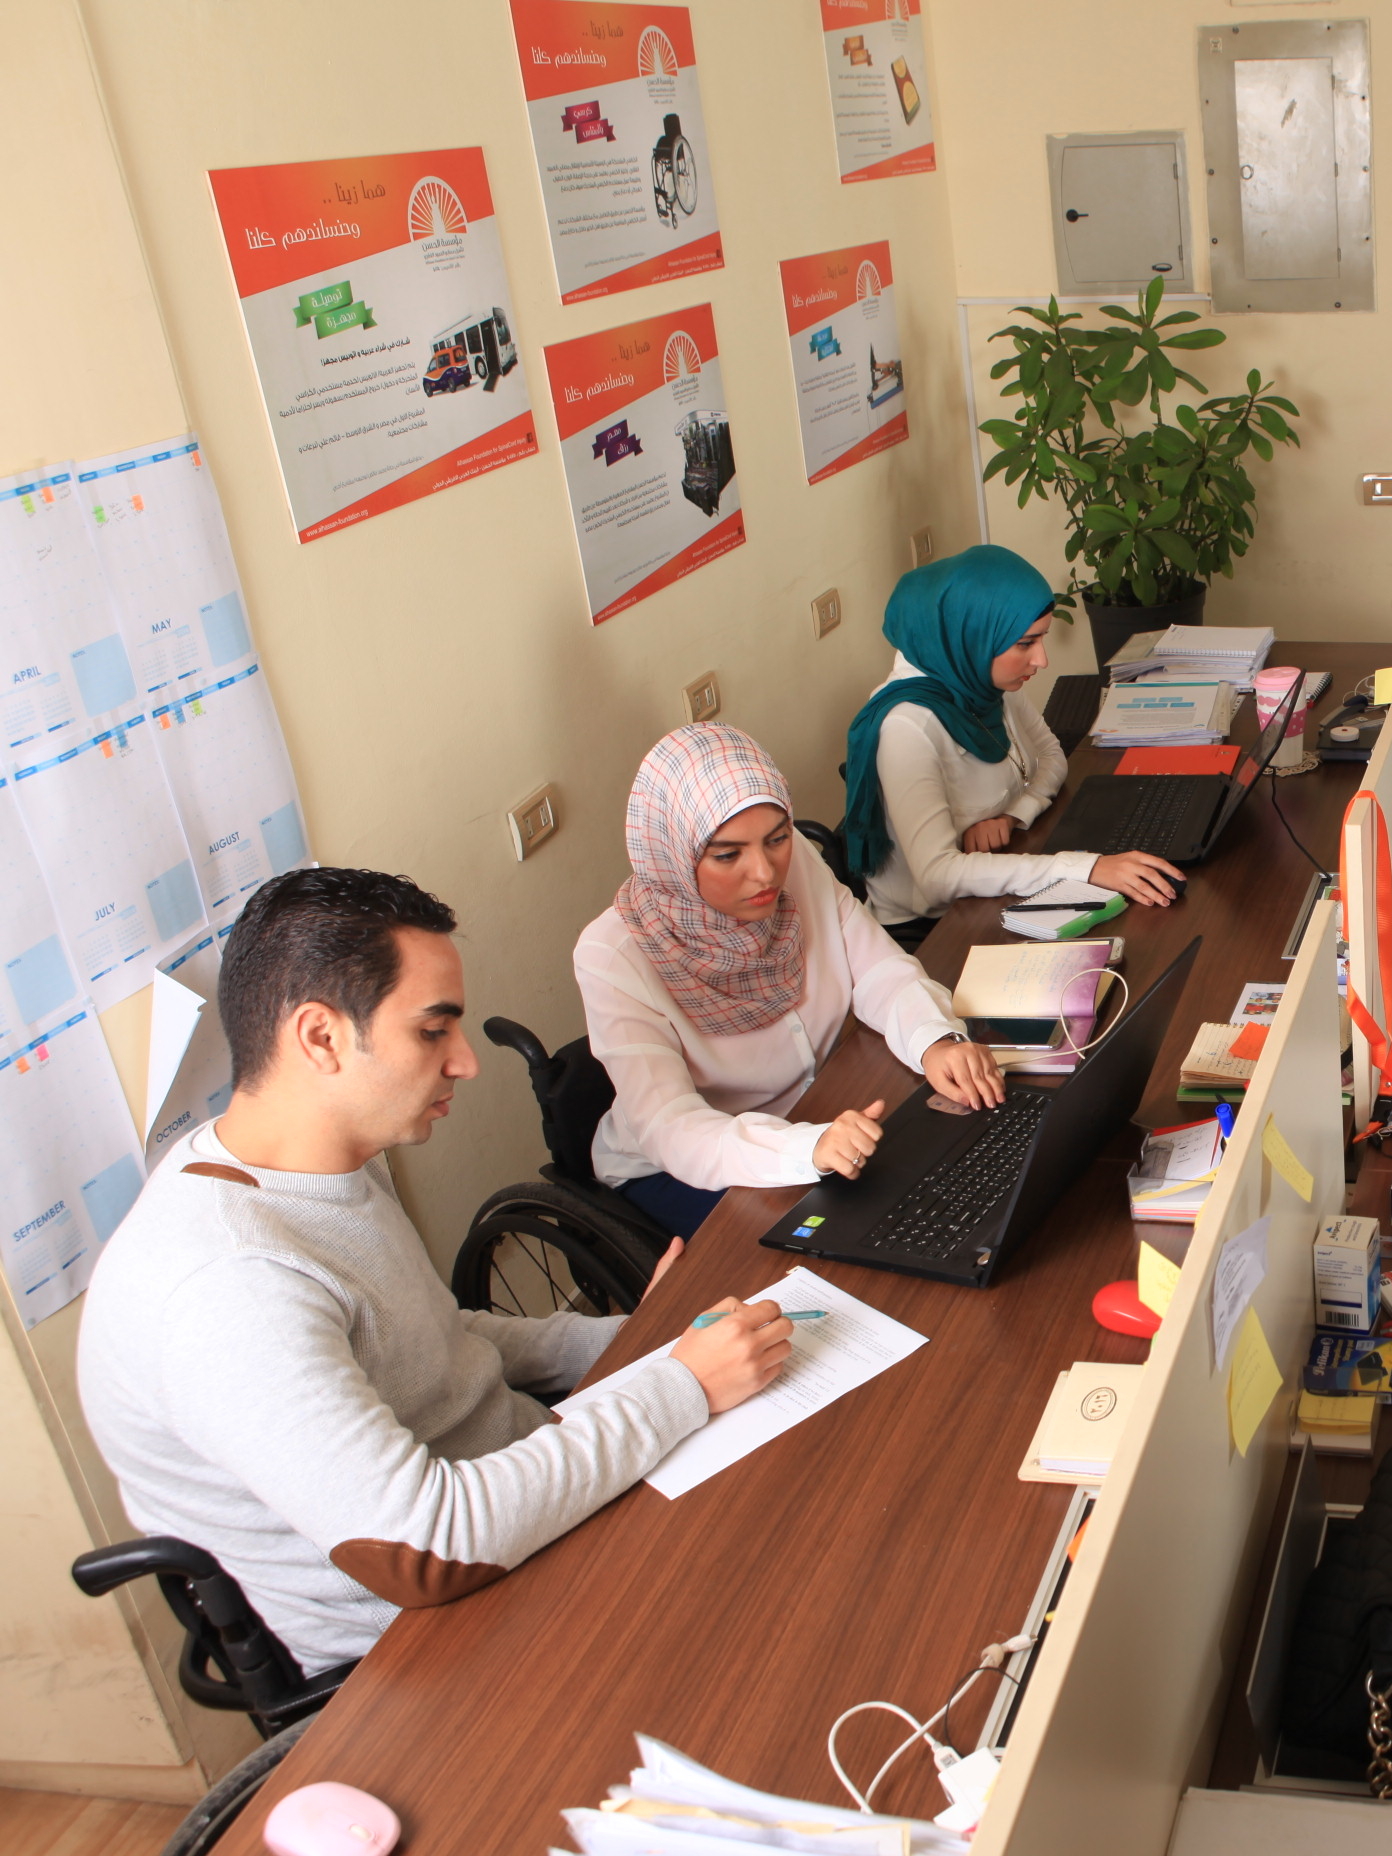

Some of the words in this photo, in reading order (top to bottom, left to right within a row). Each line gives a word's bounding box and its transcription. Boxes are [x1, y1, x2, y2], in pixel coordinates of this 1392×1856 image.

[607, 22, 624, 38] هما
[531, 46, 551, 65] كلنا
[335, 182, 358, 205] زينا
[361, 179, 386, 199] هما
[245, 227, 276, 250] كلنا
[282, 217, 361, 251] وحنساندهم
[634, 340, 651, 356] هما
[564, 385, 583, 403] كلنا
[151, 617, 173, 634] MAY
[13, 665, 42, 685] APRIL
[208, 832, 241, 856] AUGUST
[95, 902, 117, 921] JULY
[155, 1110, 193, 1144] OCTOBER
[13, 1200, 68, 1243] SEPTEMBER
[1313, 1343, 1330, 1376] Pelikan
